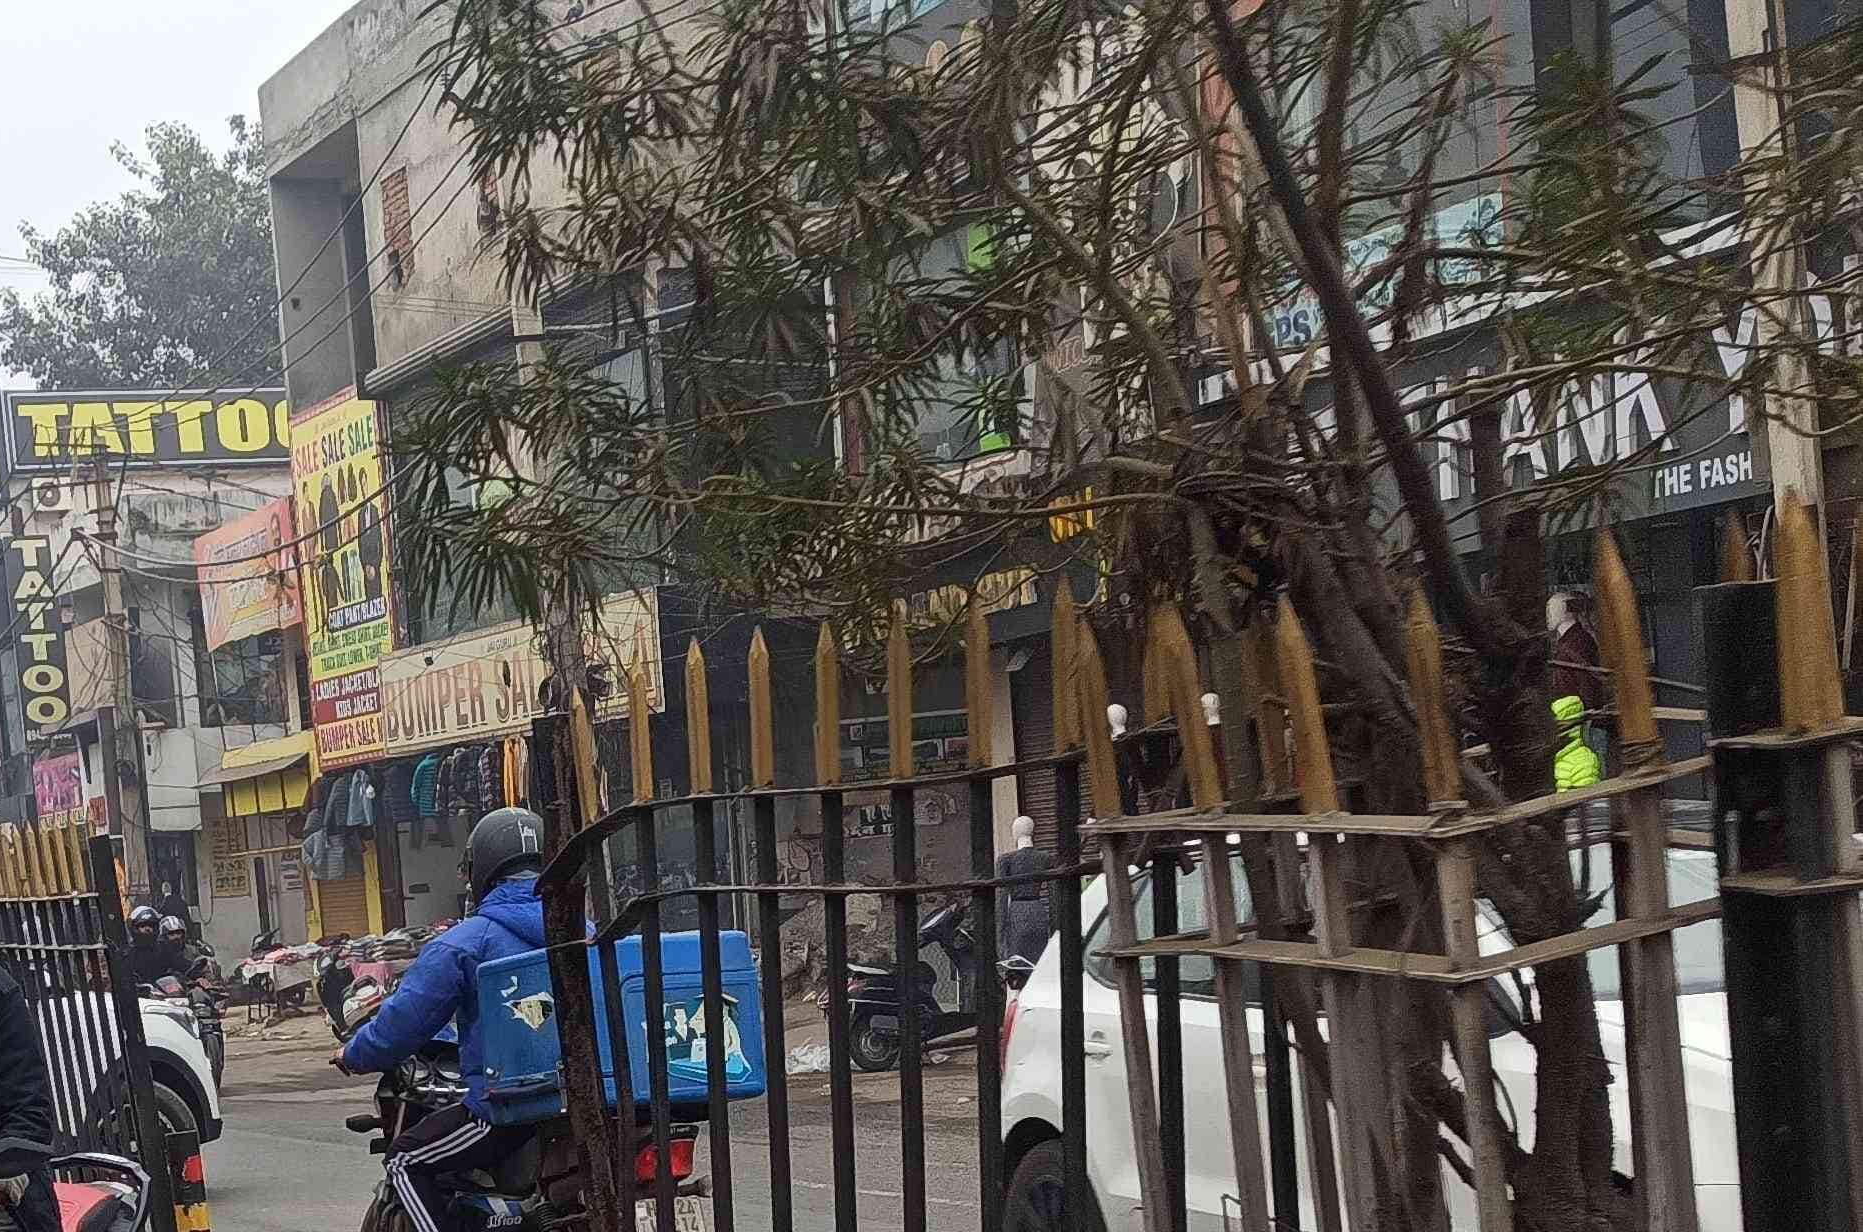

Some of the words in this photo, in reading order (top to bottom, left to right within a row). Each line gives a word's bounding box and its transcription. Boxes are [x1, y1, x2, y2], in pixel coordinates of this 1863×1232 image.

[17, 398, 290, 457] TATTO
[295, 440, 320, 479] SALE
[321, 427, 346, 469] SALE
[347, 414, 374, 457] SALE
[1654, 463, 1692, 498] THE
[1699, 450, 1753, 490] FASH
[11, 539, 67, 724] TATTOO
[315, 681, 340, 701] LADIES
[352, 691, 378, 716] JACKET
[386, 660, 488, 742] BUMPER
[495, 646, 553, 724] SAL
[320, 722, 356, 754] BUMPER
[356, 717, 377, 746] SALE
